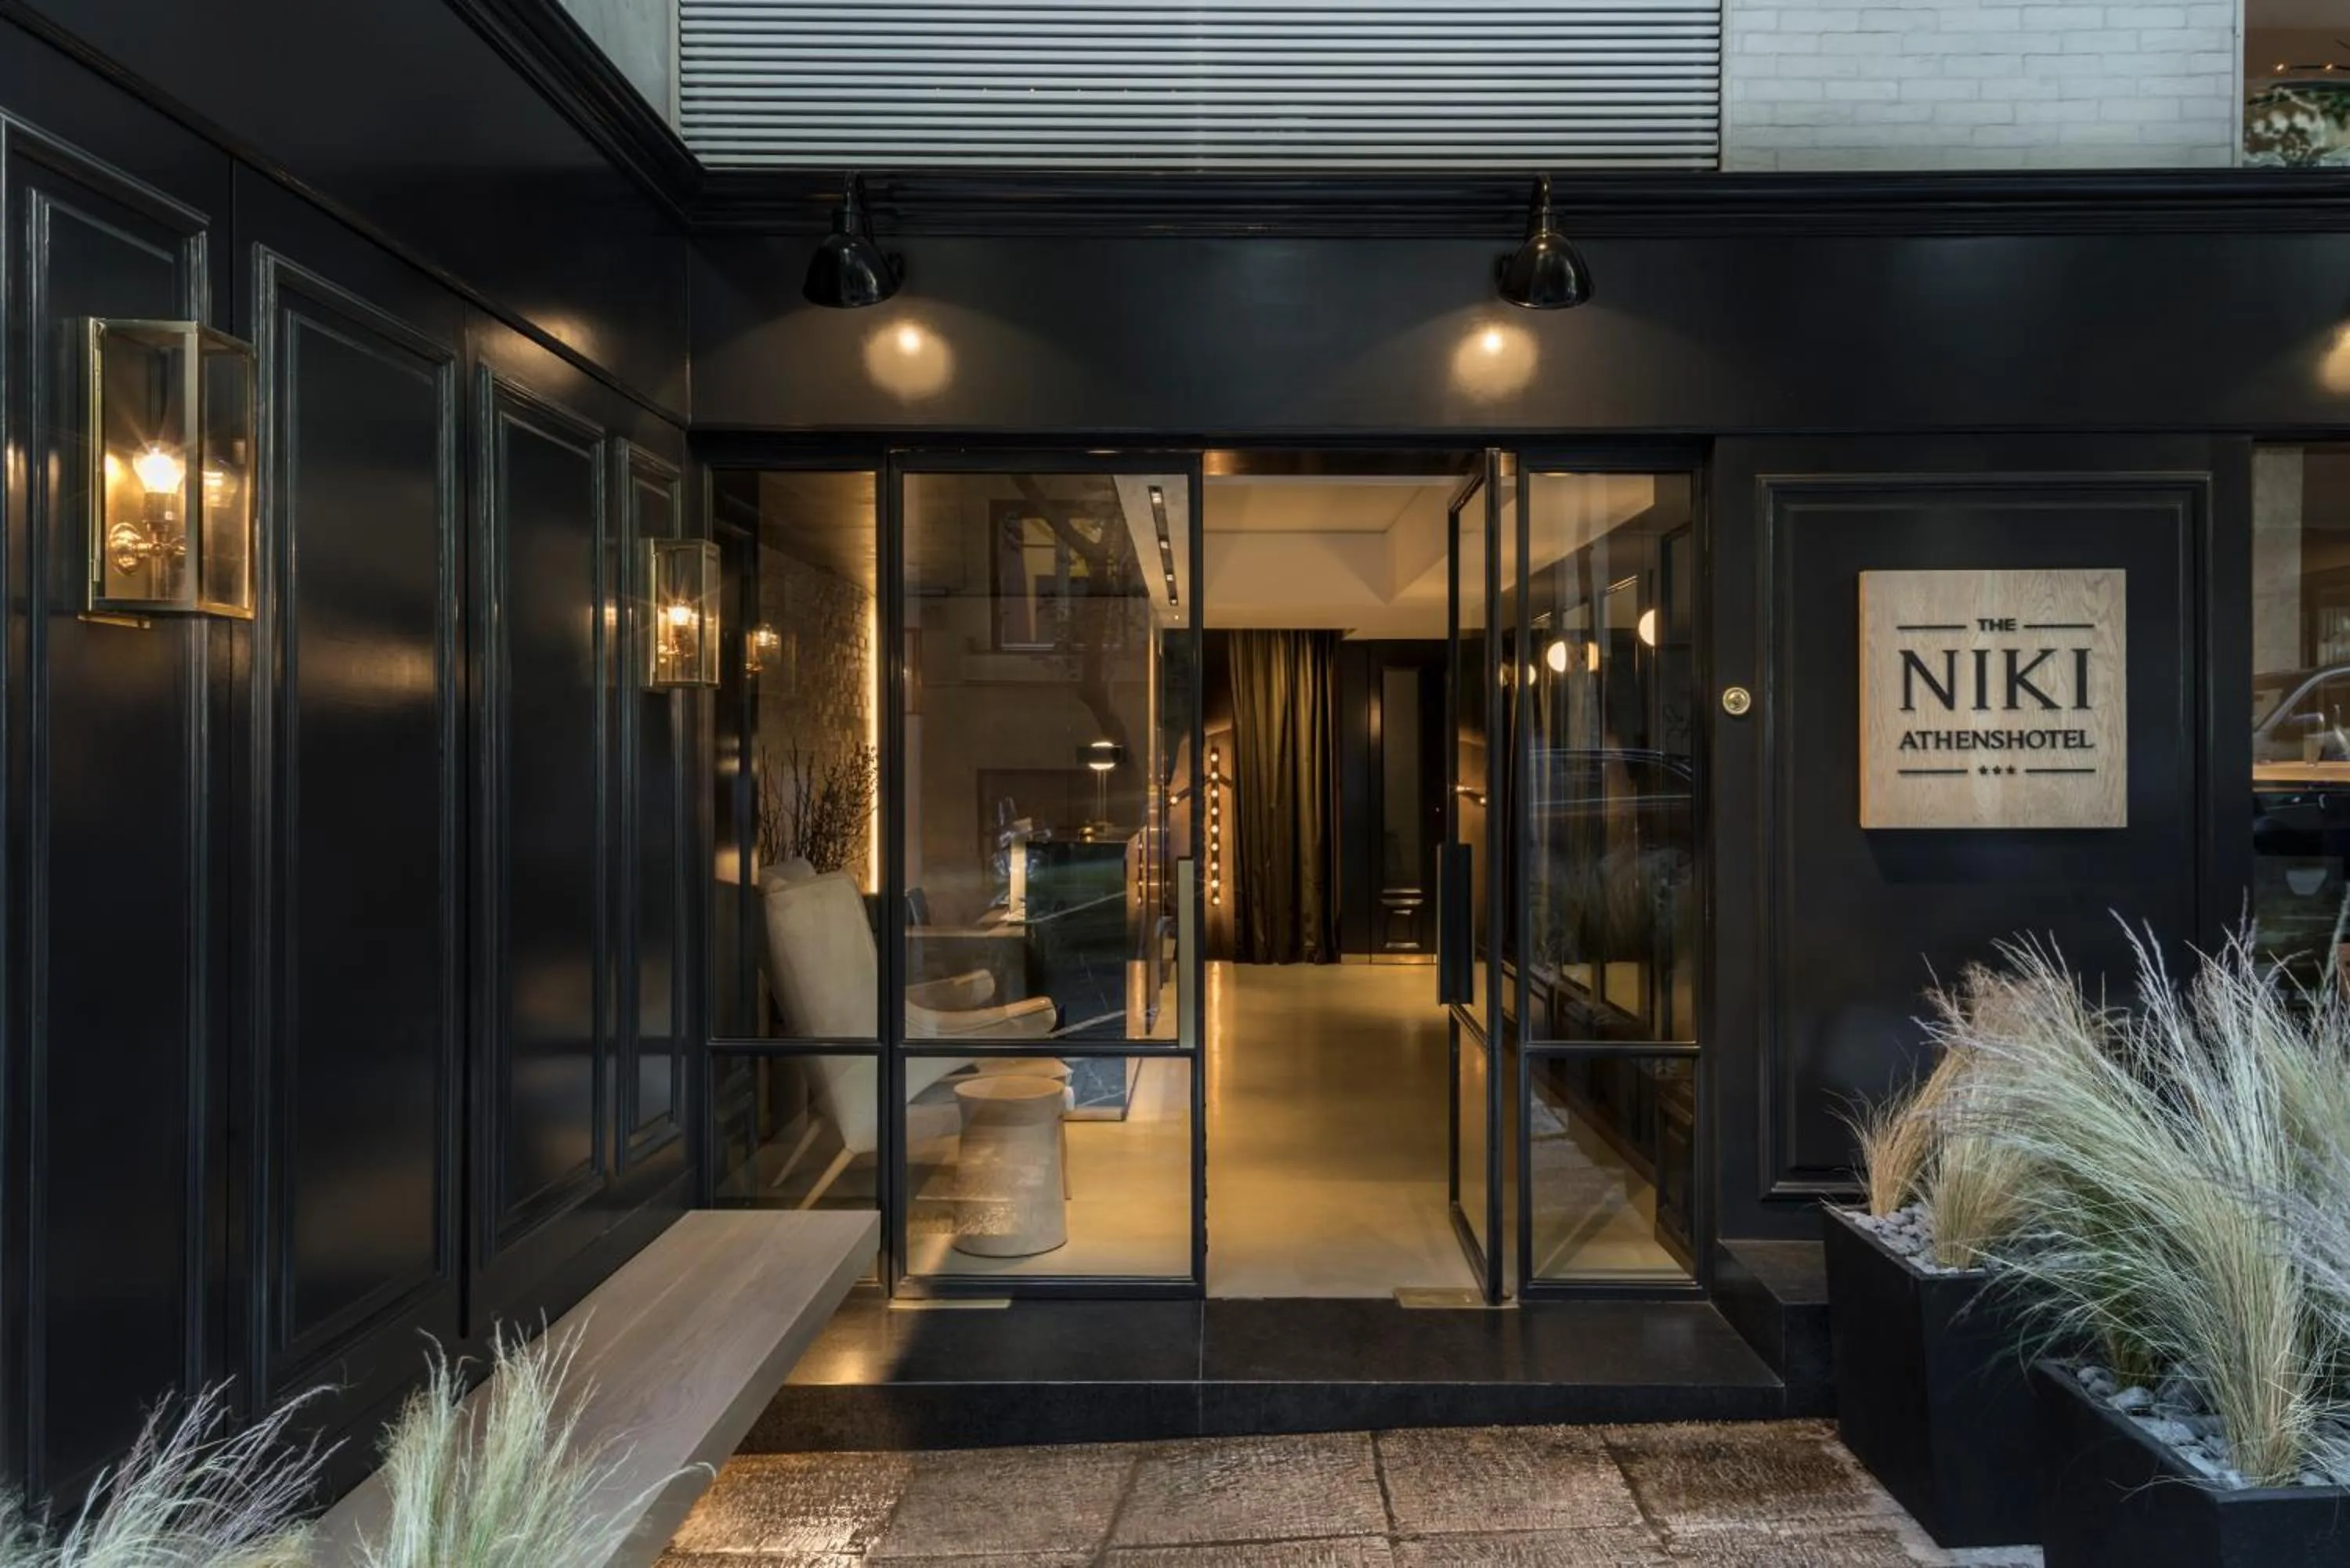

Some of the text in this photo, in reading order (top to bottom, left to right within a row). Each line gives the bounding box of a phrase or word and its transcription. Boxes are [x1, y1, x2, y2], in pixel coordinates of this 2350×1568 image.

[1977, 618, 2016, 631] THE
[1899, 648, 2092, 711] NIKI
[1899, 729, 2095, 750] ATHENSHOTEL
